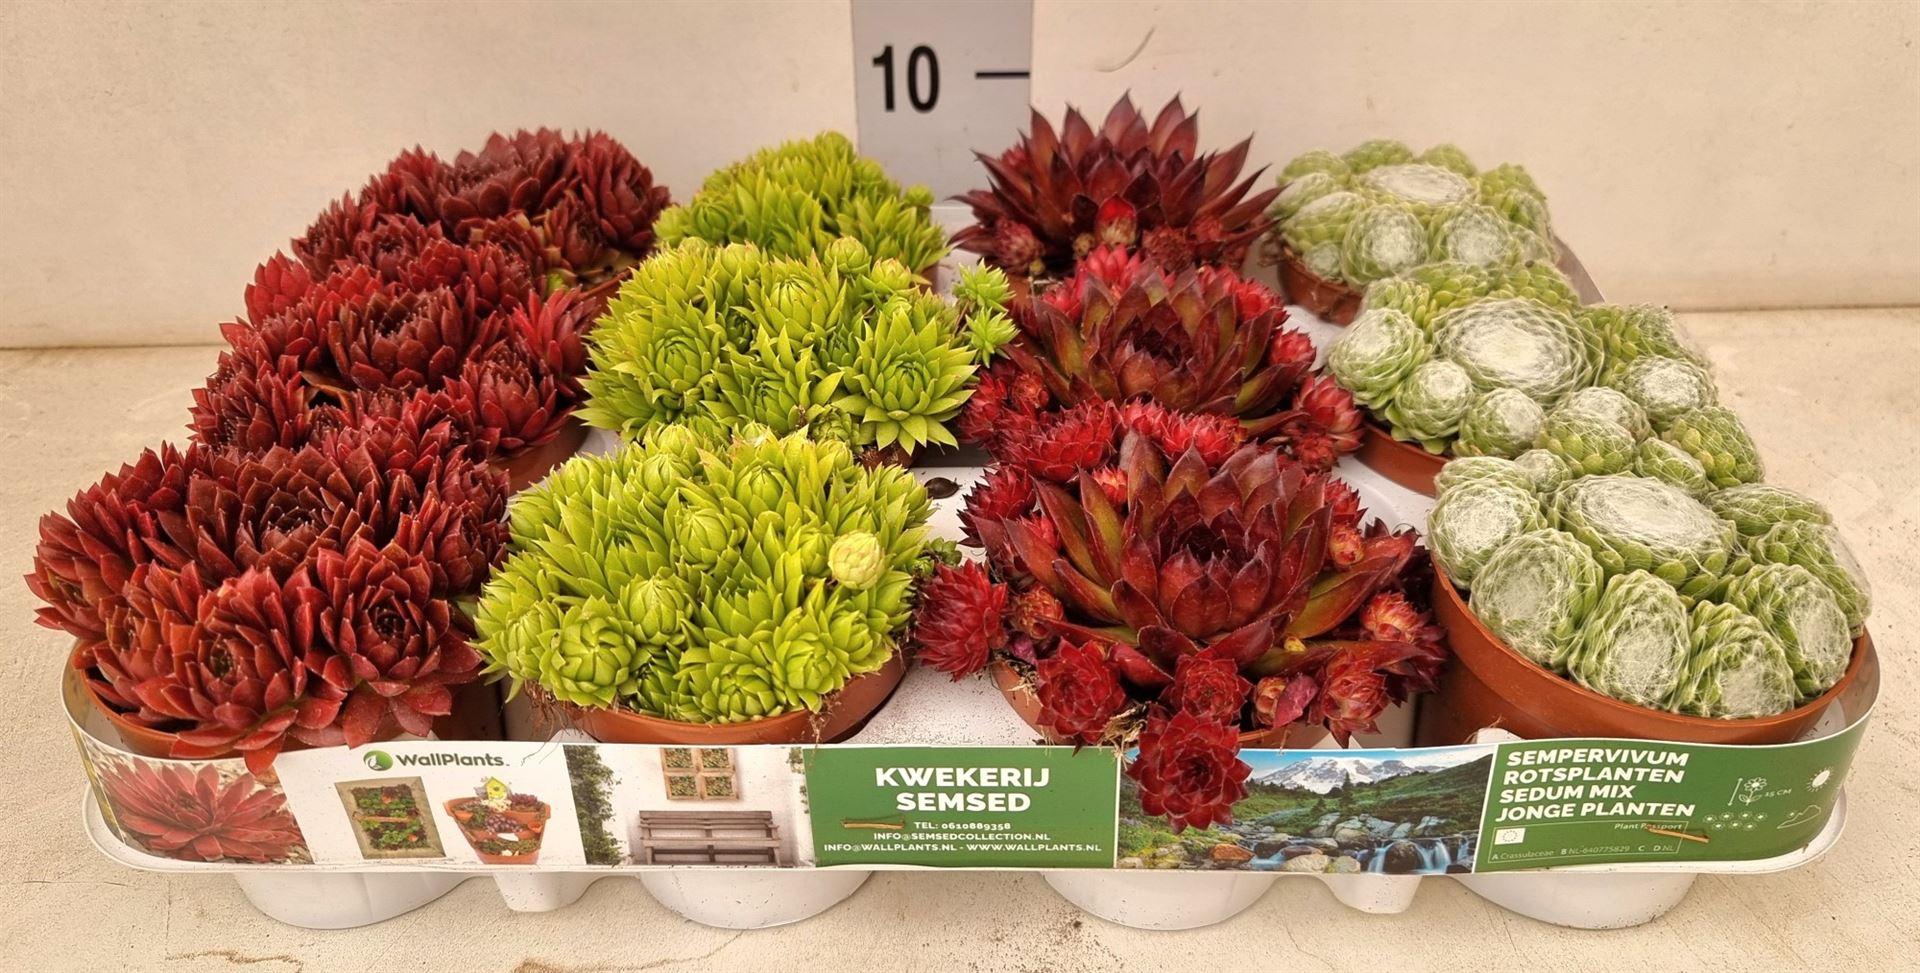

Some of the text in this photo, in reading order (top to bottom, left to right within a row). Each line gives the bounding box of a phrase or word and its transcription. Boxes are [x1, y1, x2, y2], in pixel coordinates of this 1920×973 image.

[872, 45, 940, 114] 10
[1506, 748, 1690, 767] SEMPERVIVUM
[875, 767, 1050, 787] KWEKERIJ
[1503, 767, 1685, 785] ROTSPLANTEN
[1499, 784, 1637, 804] SEDUM MIX
[1776, 788, 1793, 796] CM
[896, 792, 1031, 812] SEMSED
[1495, 803, 1696, 822] JONGE PLANTEN
[914, 821, 1011, 831] TEL: 0610889358
[873, 832, 1051, 841] INFO@SEMSEDCOLLECTION.NL
[824, 843, 958, 852] INFO@WALLPLANTS.NL
[966, 843, 1102, 852] WWW.WALLPLANTS.NL
[1500, 849, 1555, 860] Crassulaceae
[1638, 844, 1645, 852] C
[1653, 844, 1661, 852] D
